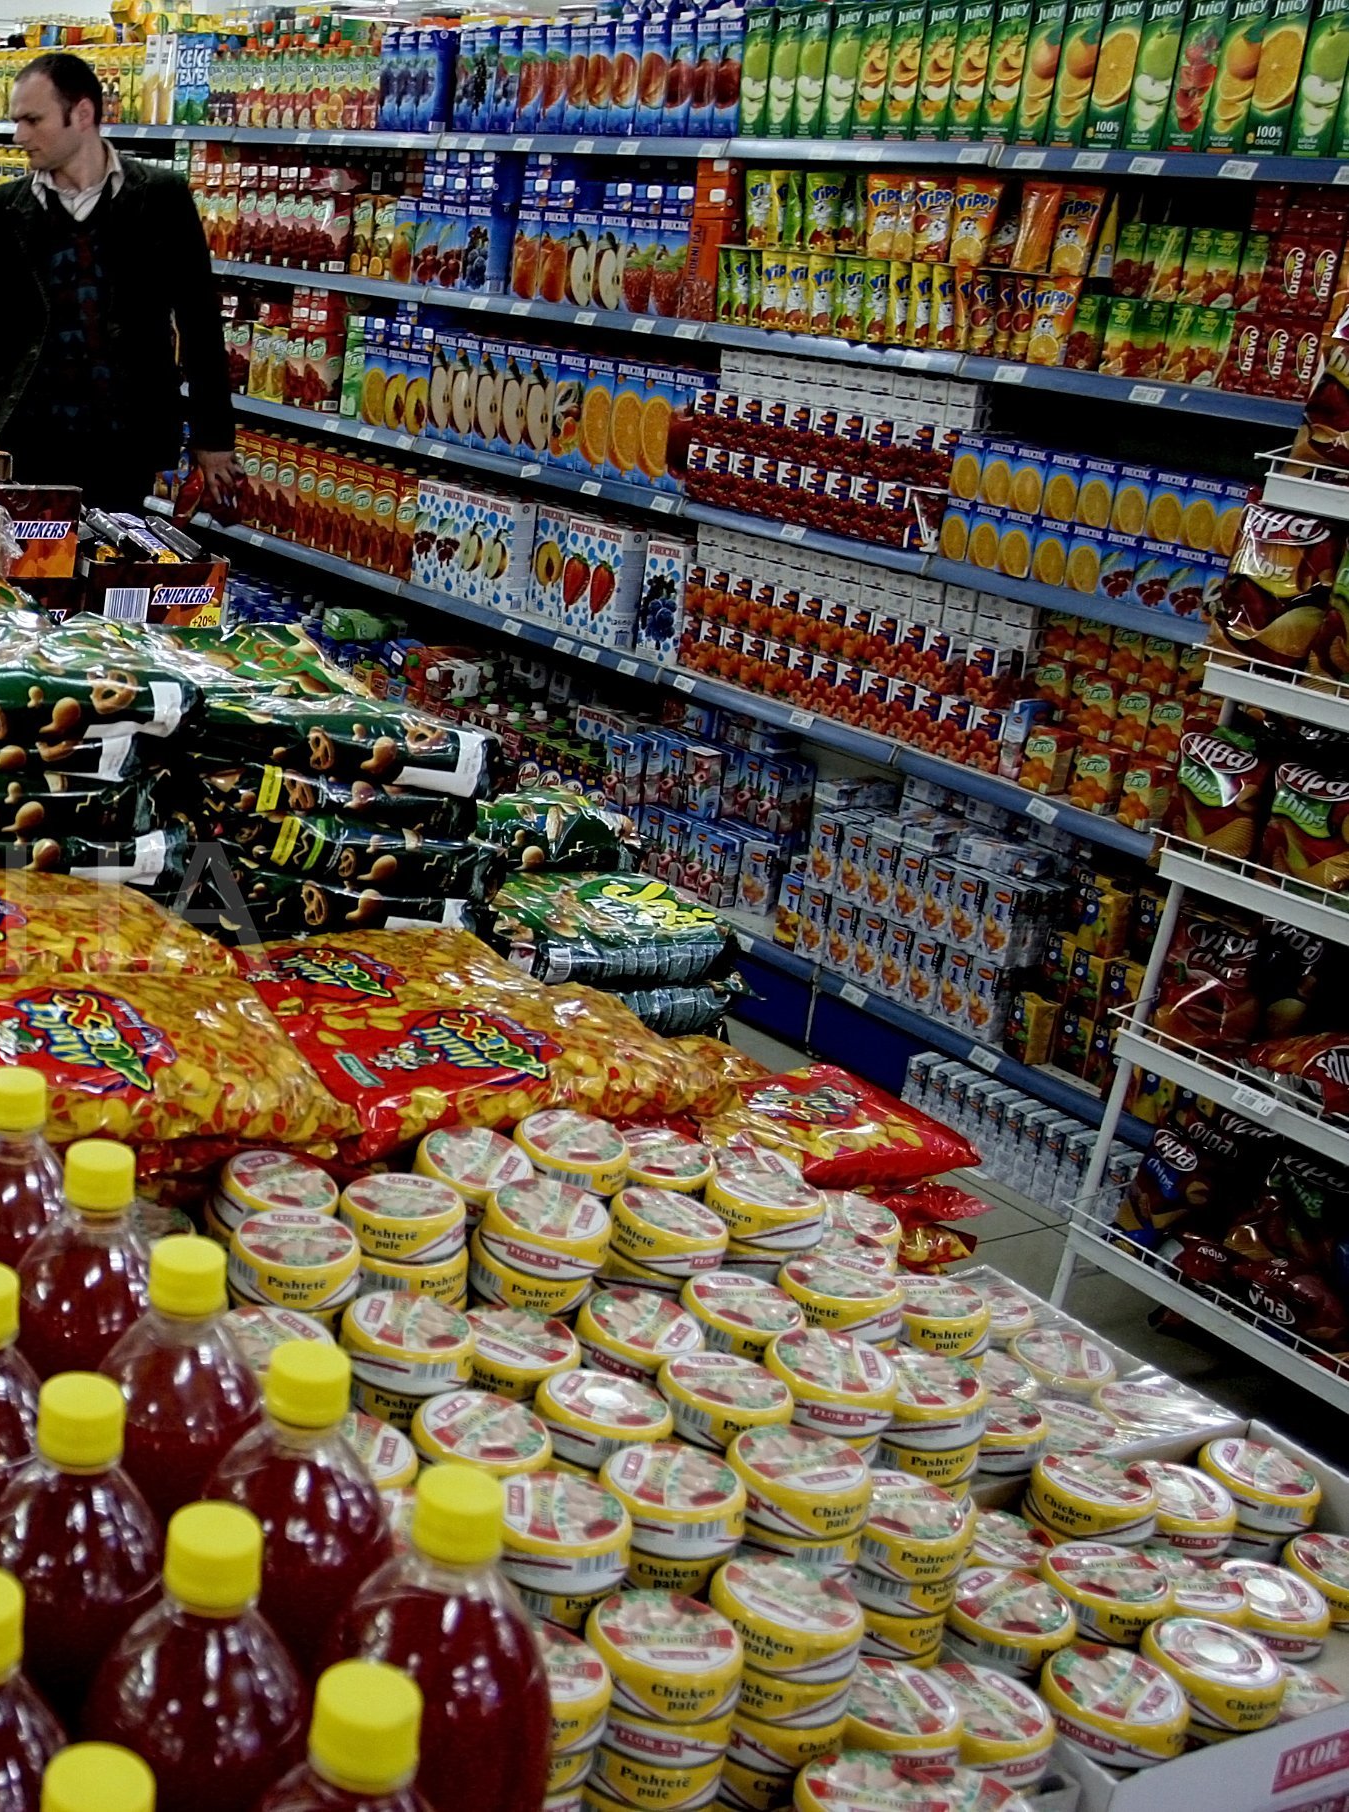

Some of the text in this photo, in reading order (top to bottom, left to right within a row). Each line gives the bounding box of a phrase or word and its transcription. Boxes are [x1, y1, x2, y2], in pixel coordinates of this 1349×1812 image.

[1095, 121, 1119, 133] 100%
[1256, 125, 1283, 138] 100%
[1254, 138, 1282, 146] ORANGE
[916, 189, 953, 210] Yipp
[153, 587, 214, 605] SNICKERS
[711, 1200, 752, 1223] Chicken
[362, 1223, 418, 1241] Pashtetë
[375, 1240, 402, 1252] pule
[267, 1276, 327, 1291] Pashtetë
[282, 1290, 310, 1302] pule
[511, 1284, 567, 1299] Pashtetë
[524, 1298, 551, 1309] pule
[920, 1327, 974, 1340] Pashtetë
[935, 1339, 960, 1351] pule
[472, 1366, 515, 1388] hicken
[910, 1453, 966, 1467] Pashtetë
[926, 1466, 952, 1478] pule
[812, 1502, 863, 1518] Chicken
[1044, 1493, 1093, 1523] Chicken
[638, 1562, 700, 1579] Chicken
[914, 1563, 942, 1575] pule
[733, 1617, 794, 1655] Chicken
[651, 1683, 716, 1701] Chicken
[1226, 1697, 1277, 1712] Chicken
[620, 1765, 692, 1789] Pashtetë
[636, 1786, 670, 1801] pule
